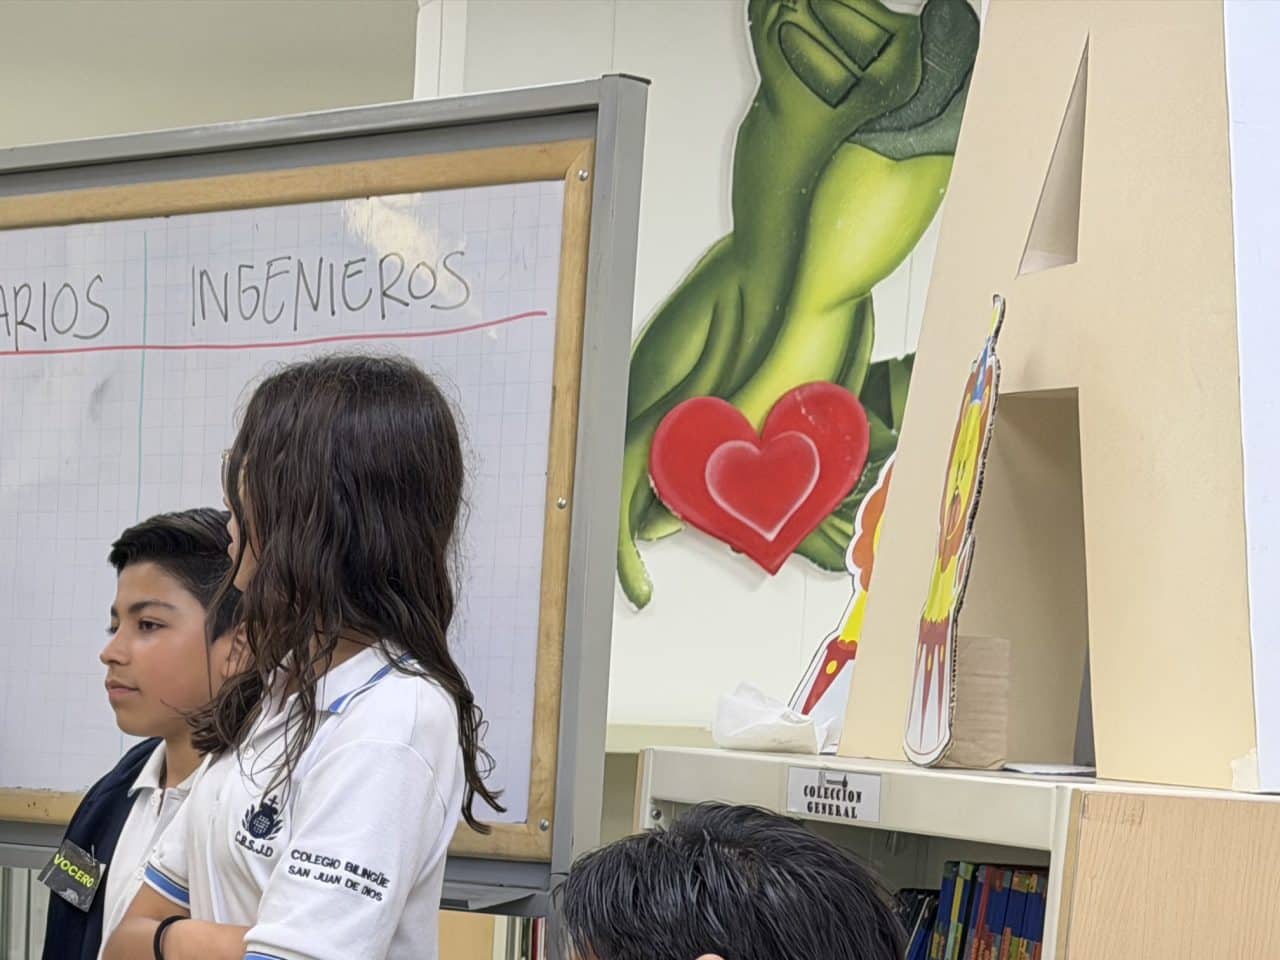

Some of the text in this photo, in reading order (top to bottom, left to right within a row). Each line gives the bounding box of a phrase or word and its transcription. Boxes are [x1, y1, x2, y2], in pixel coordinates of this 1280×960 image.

[190, 250, 472, 332] INGENIEROS
[807, 801, 858, 819] GENERAL
[53, 853, 95, 888] VOCERO
[288, 865, 383, 901] SAN JUAN DE DIOS
[291, 849, 390, 888] COLEGIO BILINGÜE
